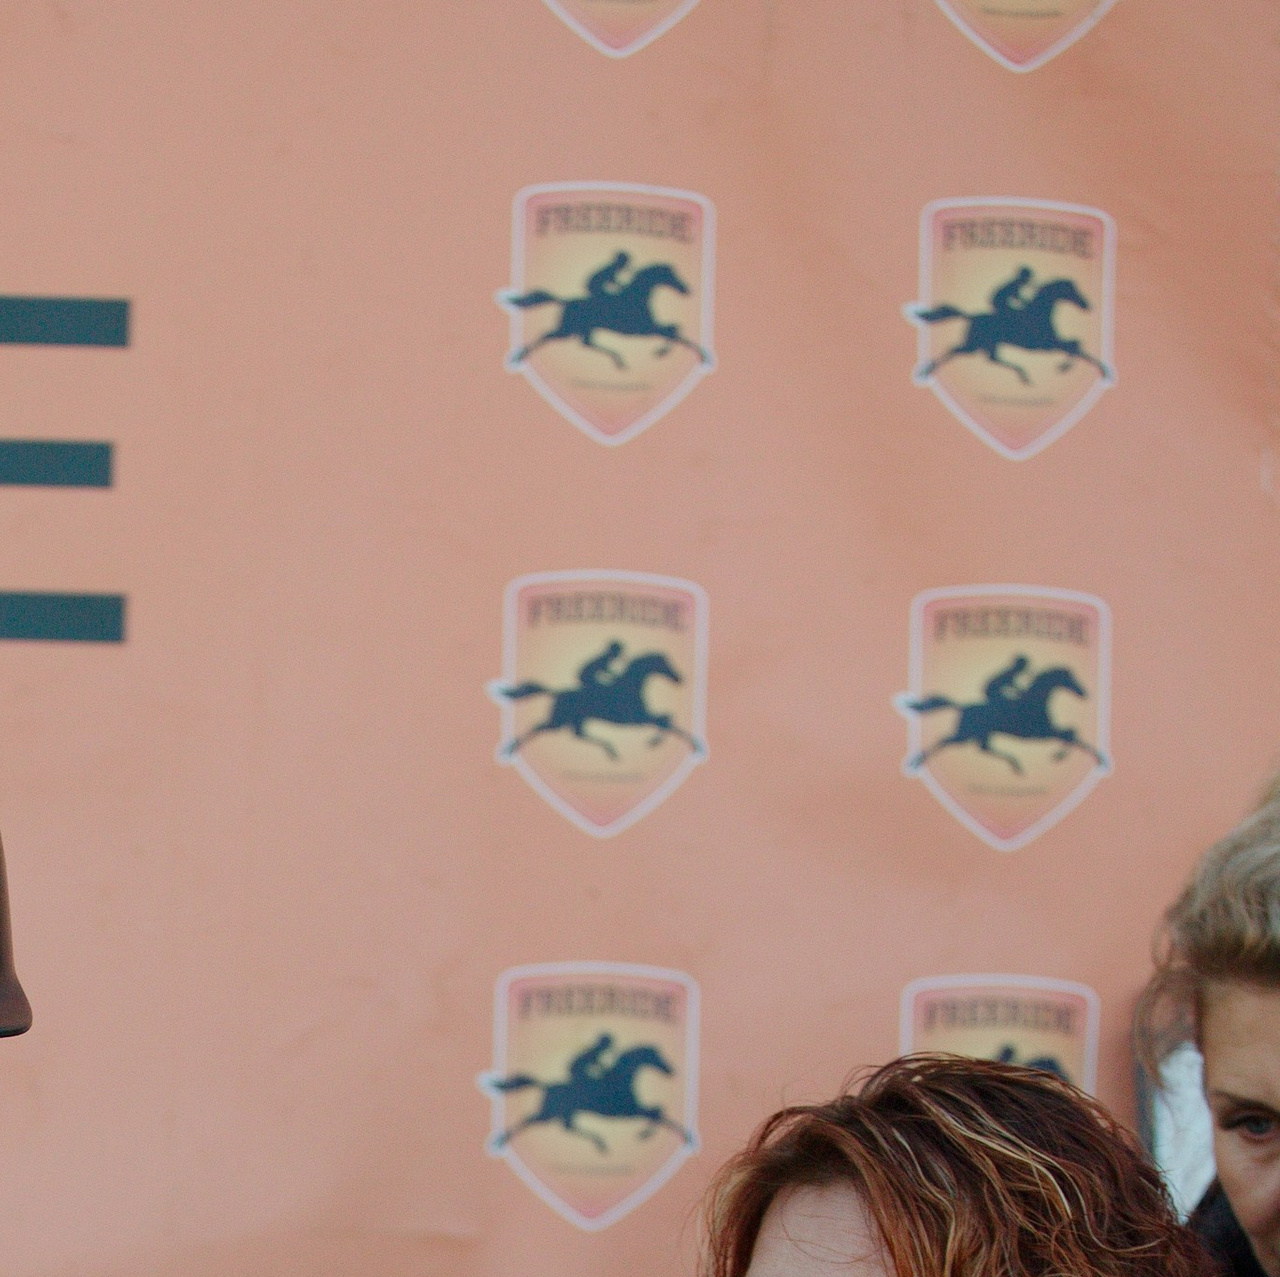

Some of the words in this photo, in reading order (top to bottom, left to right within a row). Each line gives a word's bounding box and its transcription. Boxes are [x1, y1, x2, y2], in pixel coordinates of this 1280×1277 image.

[535, 202, 694, 246] FREERIDE
[942, 219, 1094, 259] FREERIDE
[528, 592, 689, 633] FREERIDE
[934, 607, 1089, 646] FREERIDE
[519, 983, 677, 1025] FREERIDE
[924, 997, 1074, 1035] FREERIDE
